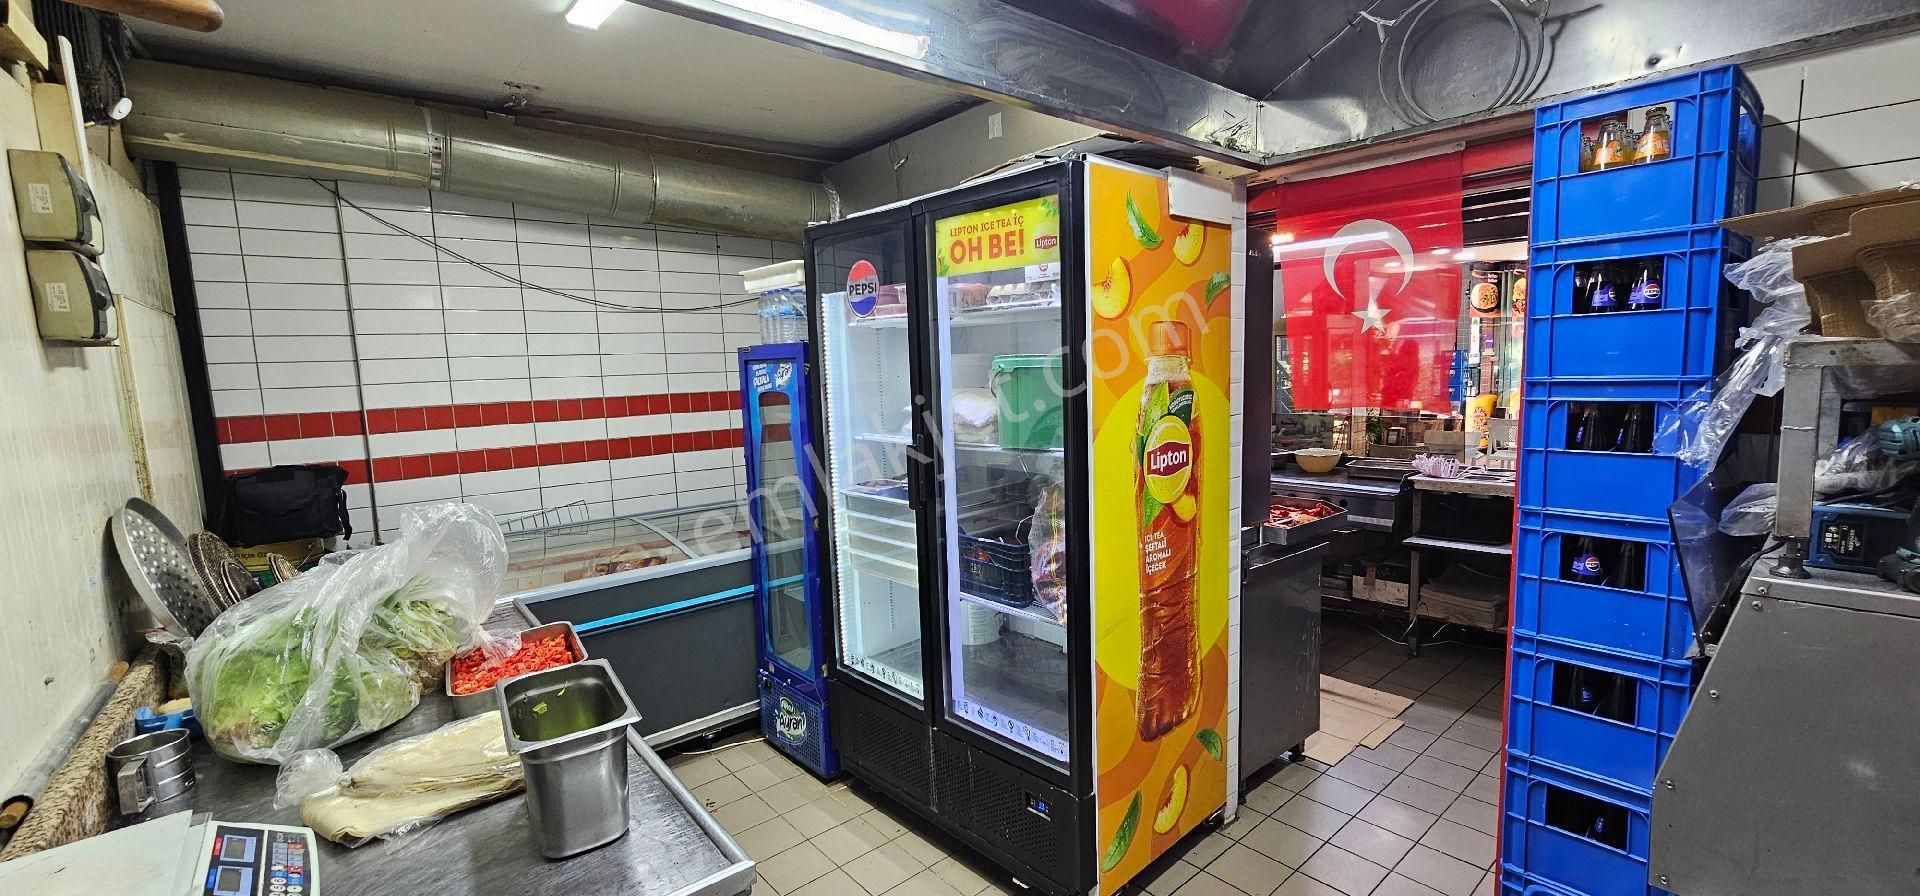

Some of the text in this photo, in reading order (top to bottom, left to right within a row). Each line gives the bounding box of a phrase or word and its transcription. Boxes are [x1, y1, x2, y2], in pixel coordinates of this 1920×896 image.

[950, 213, 1024, 237] LIPTON ICE TEA İÇ
[950, 229, 1025, 265] OH BE!
[1036, 237, 1057, 249] Lipton
[849, 282, 877, 297] PEPSI
[1150, 449, 1187, 473] Lipton
[1144, 530, 1165, 543] ICE TEA
[1144, 537, 1167, 554] ŞEFTALİ
[1145, 548, 1171, 563] AROMALI
[1145, 560, 1167, 576] İÇECEK
